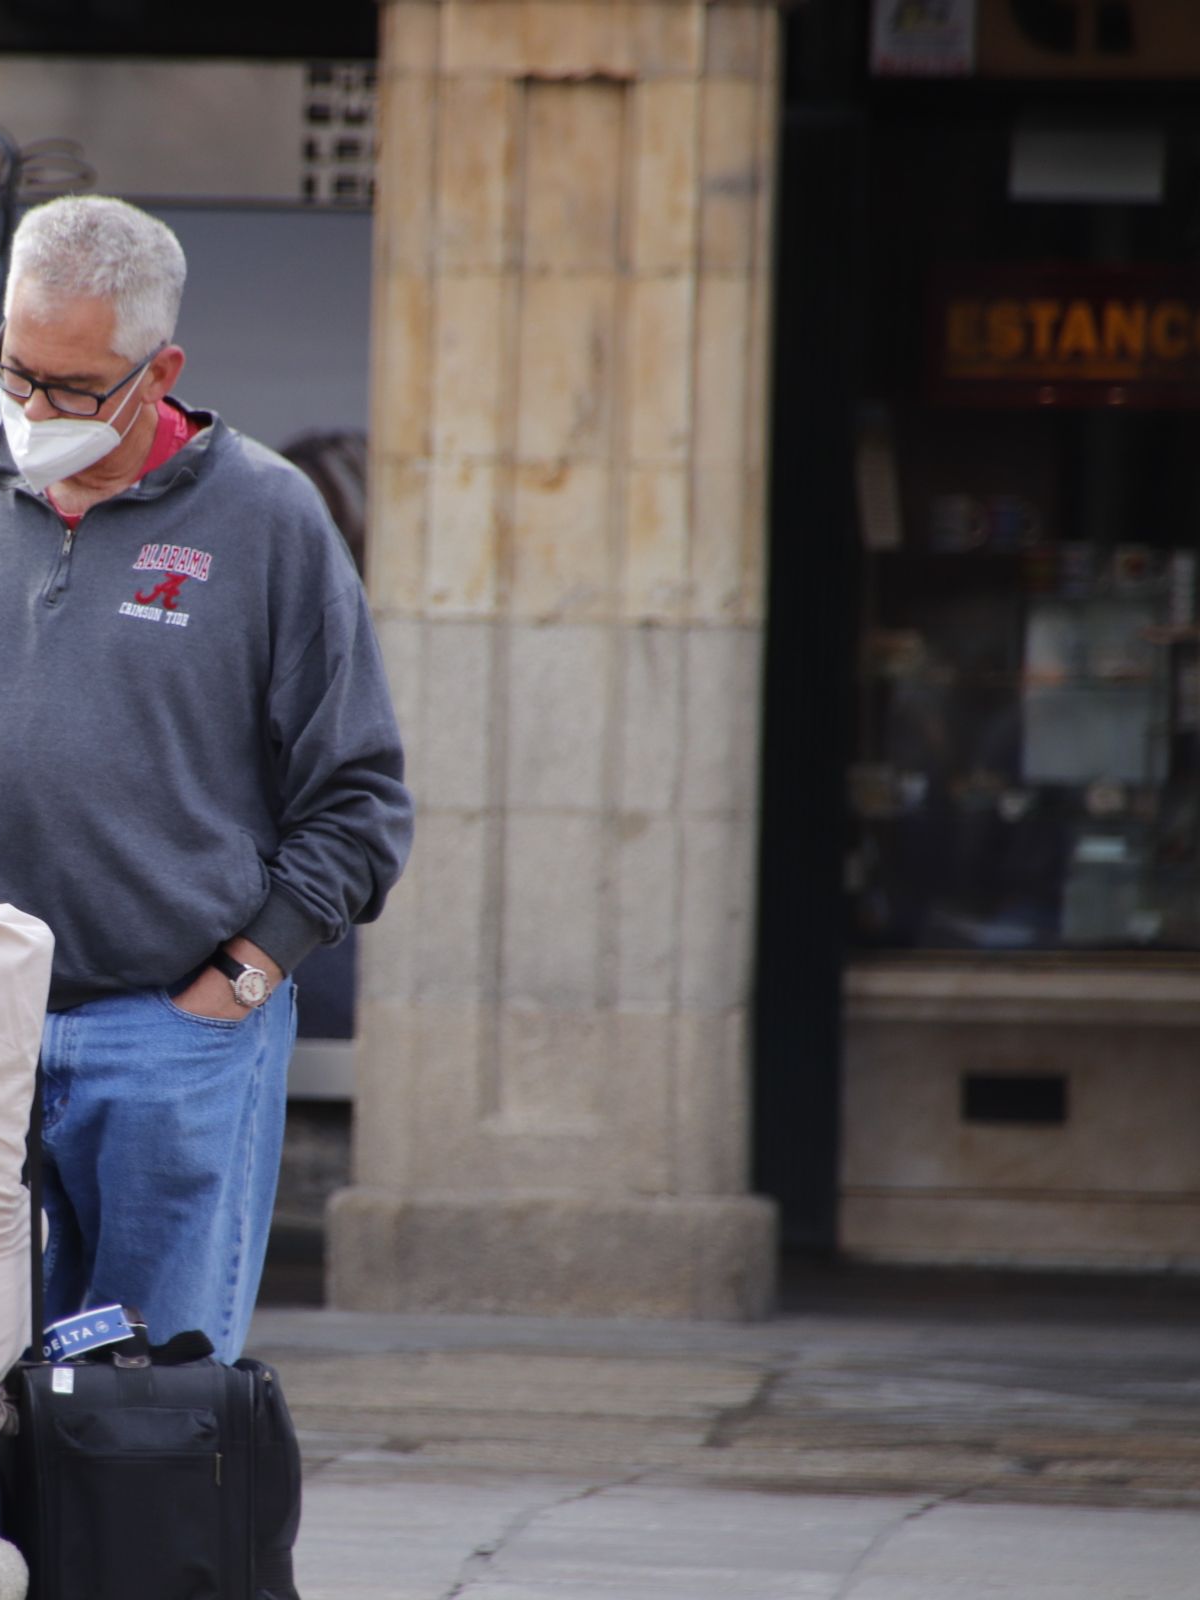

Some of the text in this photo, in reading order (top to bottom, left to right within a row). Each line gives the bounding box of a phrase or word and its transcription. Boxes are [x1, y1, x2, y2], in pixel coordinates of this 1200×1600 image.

[947, 299, 1200, 357] ESTANC
[133, 544, 212, 582] ALABAMA
[119, 601, 189, 627] CRIMSON TIDE
[42, 1326, 94, 1357] DELTA
